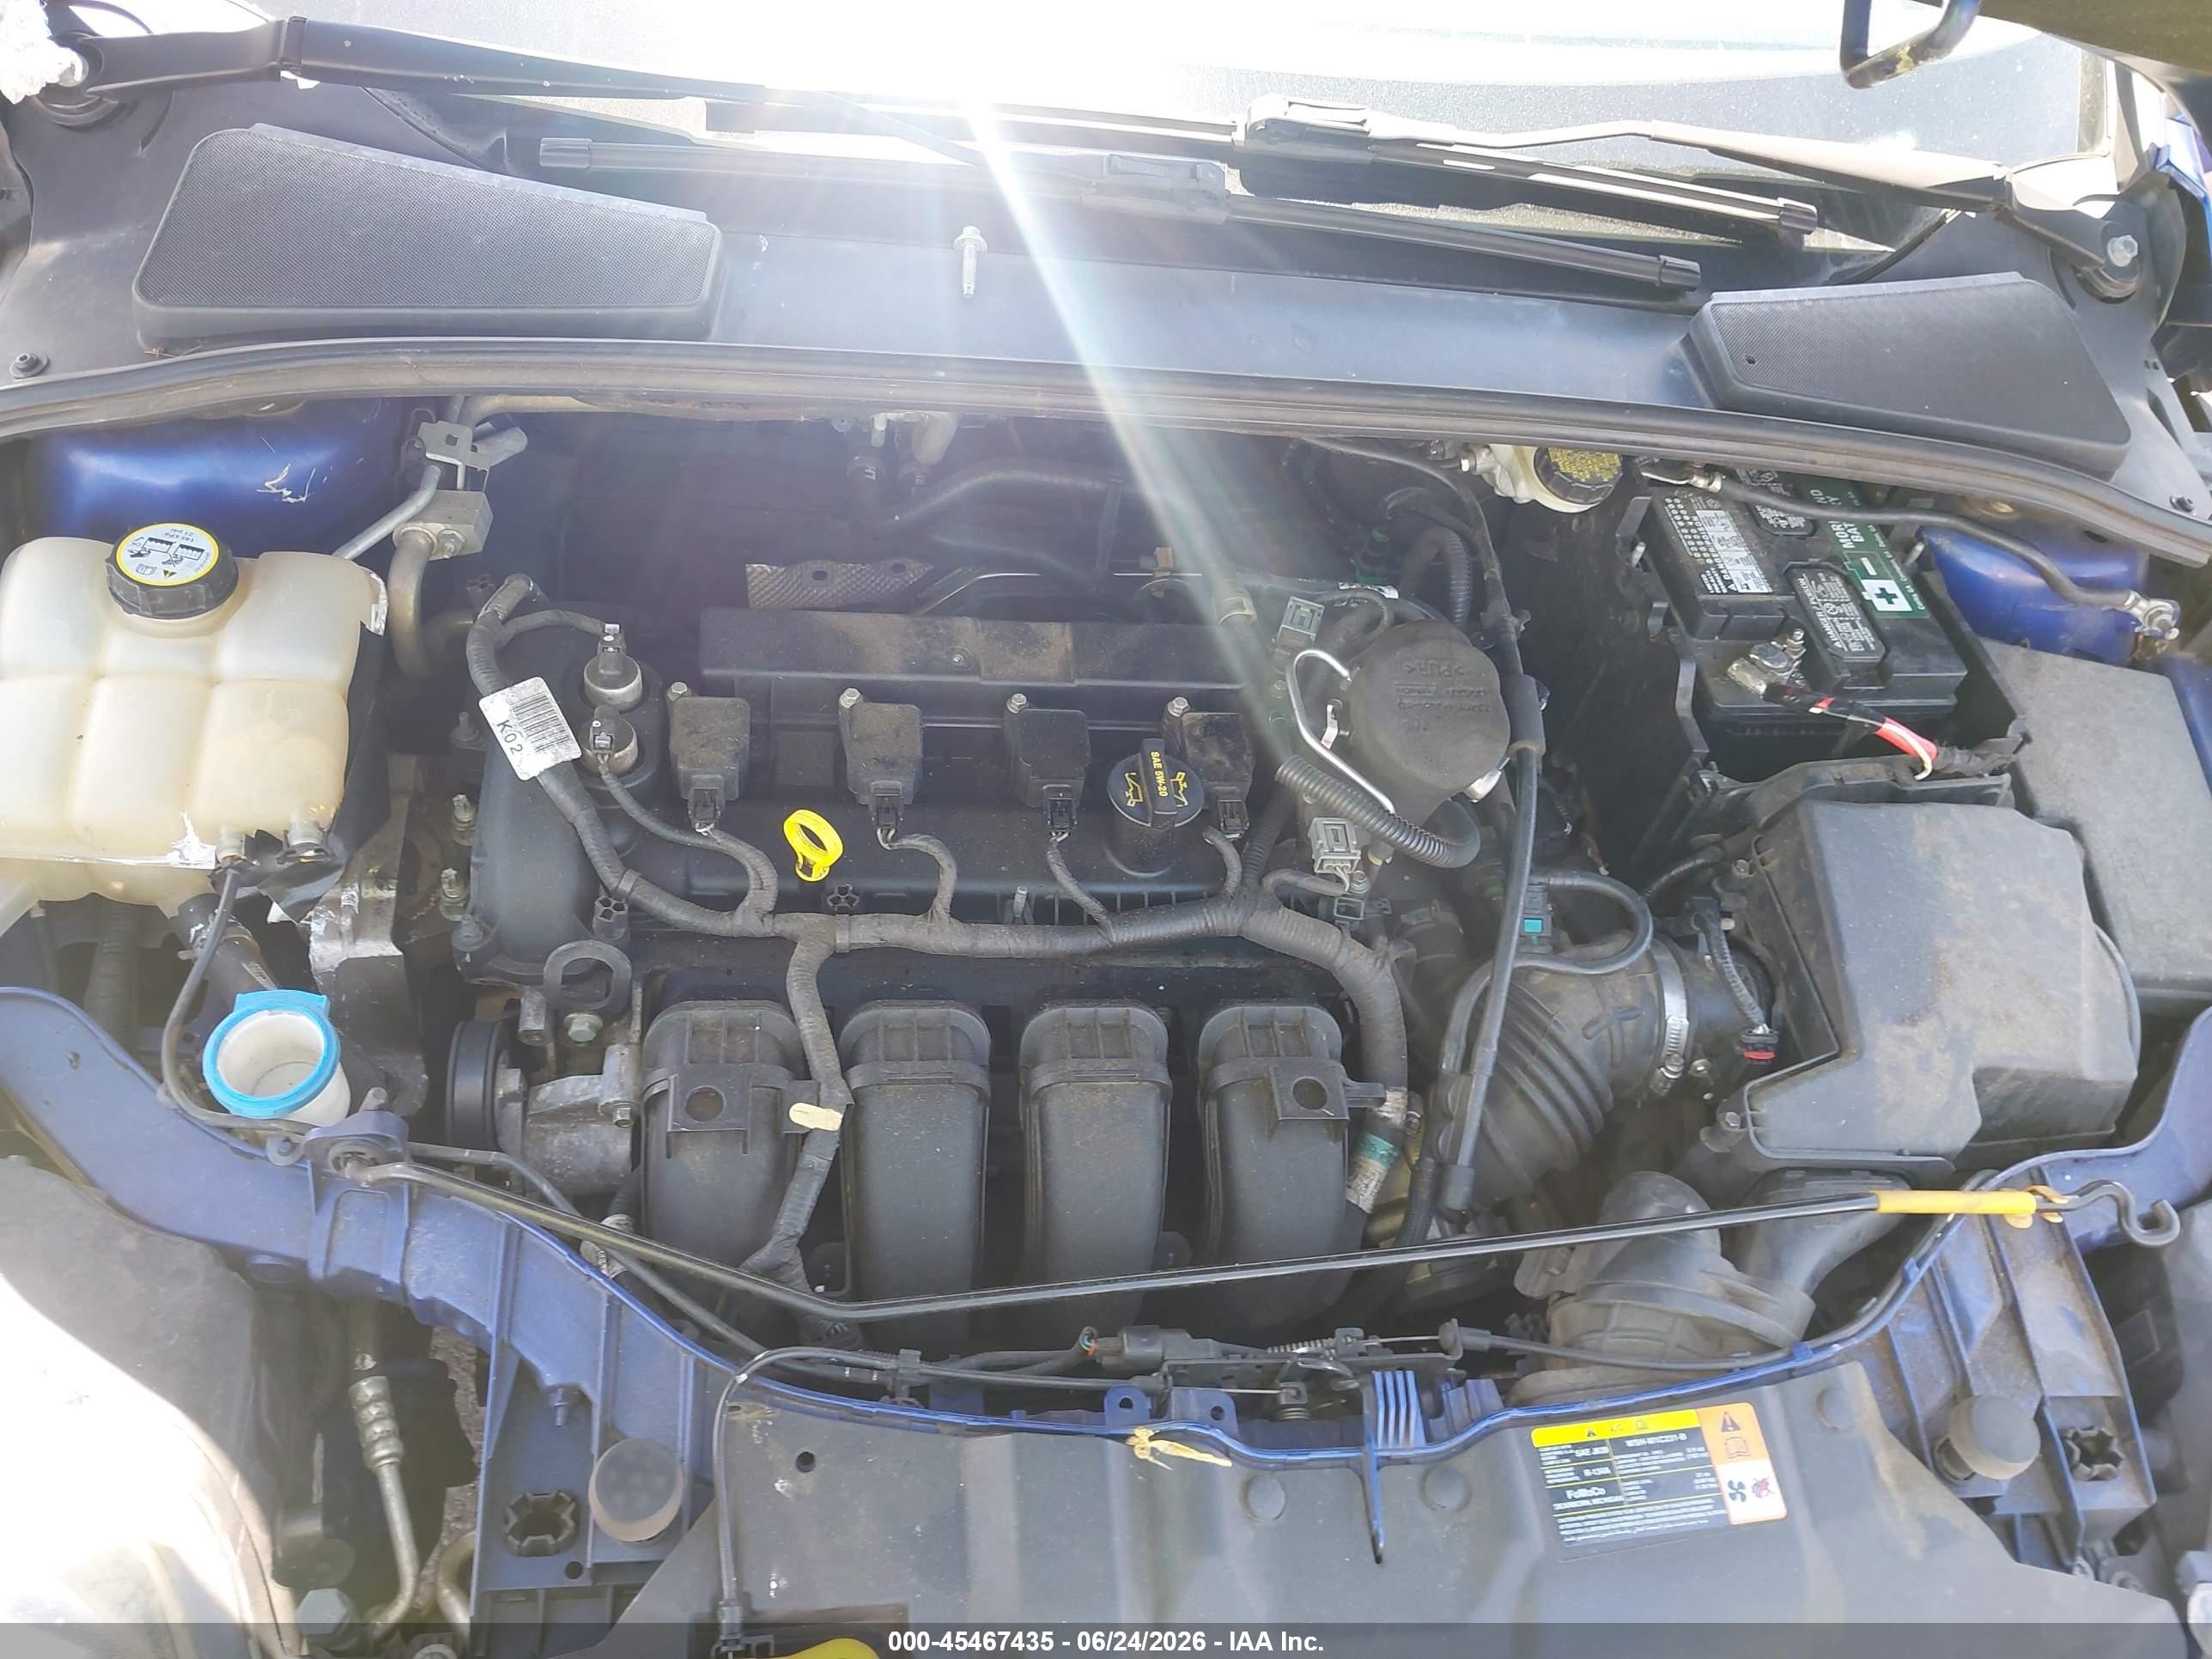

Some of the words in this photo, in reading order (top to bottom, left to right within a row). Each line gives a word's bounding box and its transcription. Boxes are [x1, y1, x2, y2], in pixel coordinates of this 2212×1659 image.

[1809, 489, 1855, 549] MORND
[1826, 496, 1865, 543] BATY
[496, 720, 524, 755] K02
[1151, 751, 1162, 769] SAE
[1155, 770, 1169, 797] 5W-20
